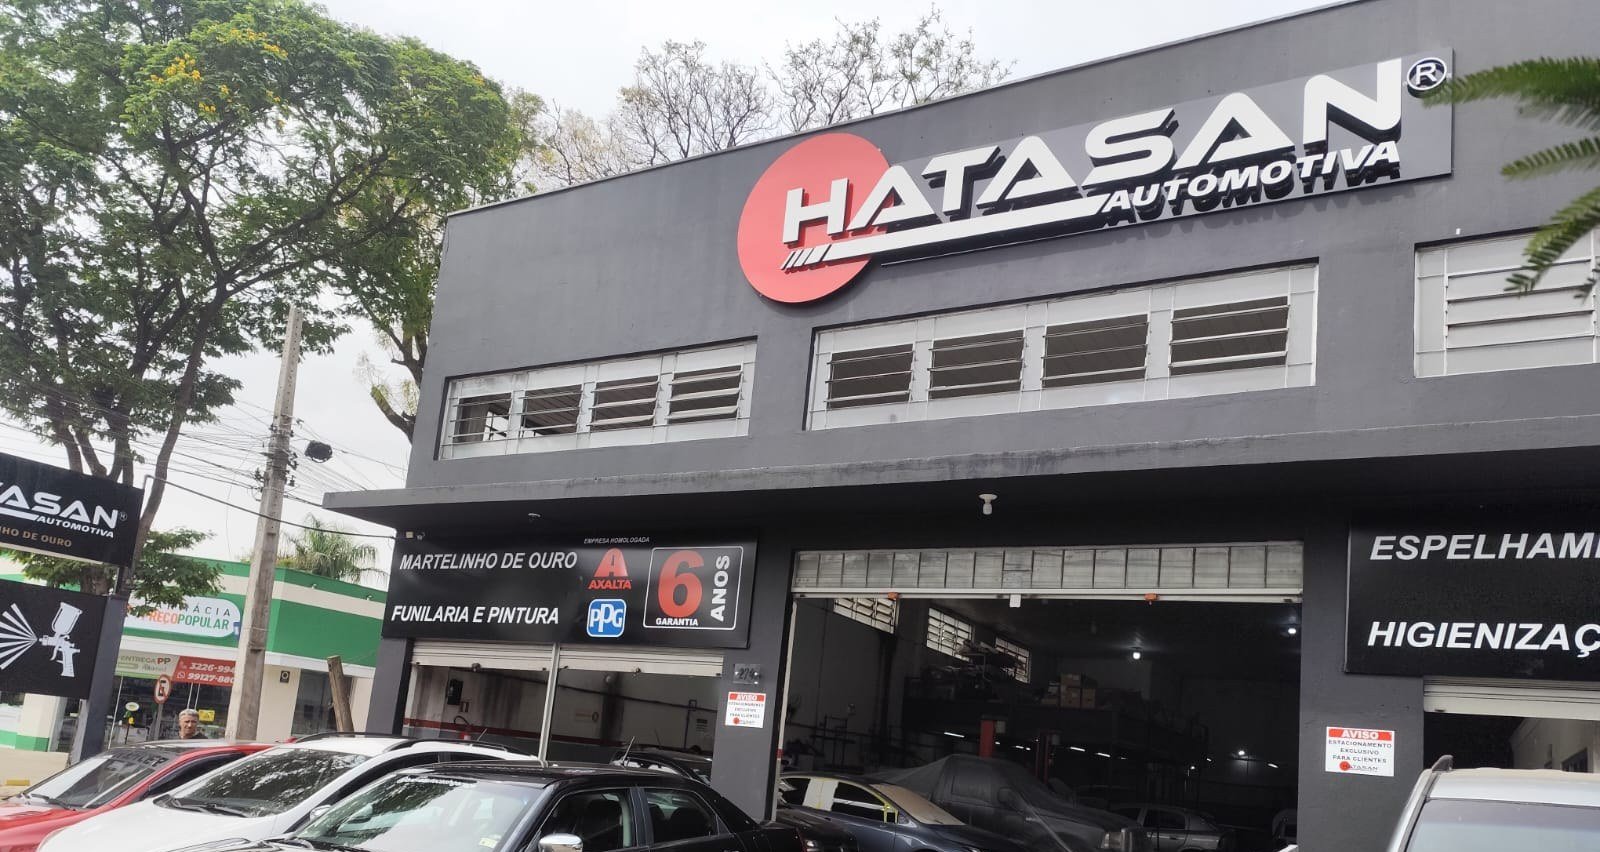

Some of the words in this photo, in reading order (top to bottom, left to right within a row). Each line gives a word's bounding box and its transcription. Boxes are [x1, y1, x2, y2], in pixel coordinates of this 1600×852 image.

[782, 56, 1402, 244] HATASAN
[1101, 140, 1400, 213] AUTOMOTIVA
[0, 482, 119, 529] ASAN
[36, 515, 115, 539] AUTOMOTIVA
[22, 531, 38, 541] DE
[41, 534, 72, 548] OURO
[1370, 532, 1600, 561] ESPELHAM
[400, 553, 498, 570] MARTELINHO
[501, 552, 525, 569] DE
[528, 551, 578, 569] OURO
[588, 579, 632, 590] AXALTA
[657, 550, 704, 618] 6
[711, 555, 730, 622] ANOS
[391, 605, 469, 622] FUNILARIA
[472, 606, 486, 623] E
[487, 606, 560, 624] PINTURA
[590, 603, 624, 633] PPG
[656, 617, 699, 627] GARANTIA
[1328, 739, 1392, 749] ESTACIONAMENTO
[1342, 729, 1379, 740] AVISO
[1340, 747, 1380, 756] EXCLUSIVO
